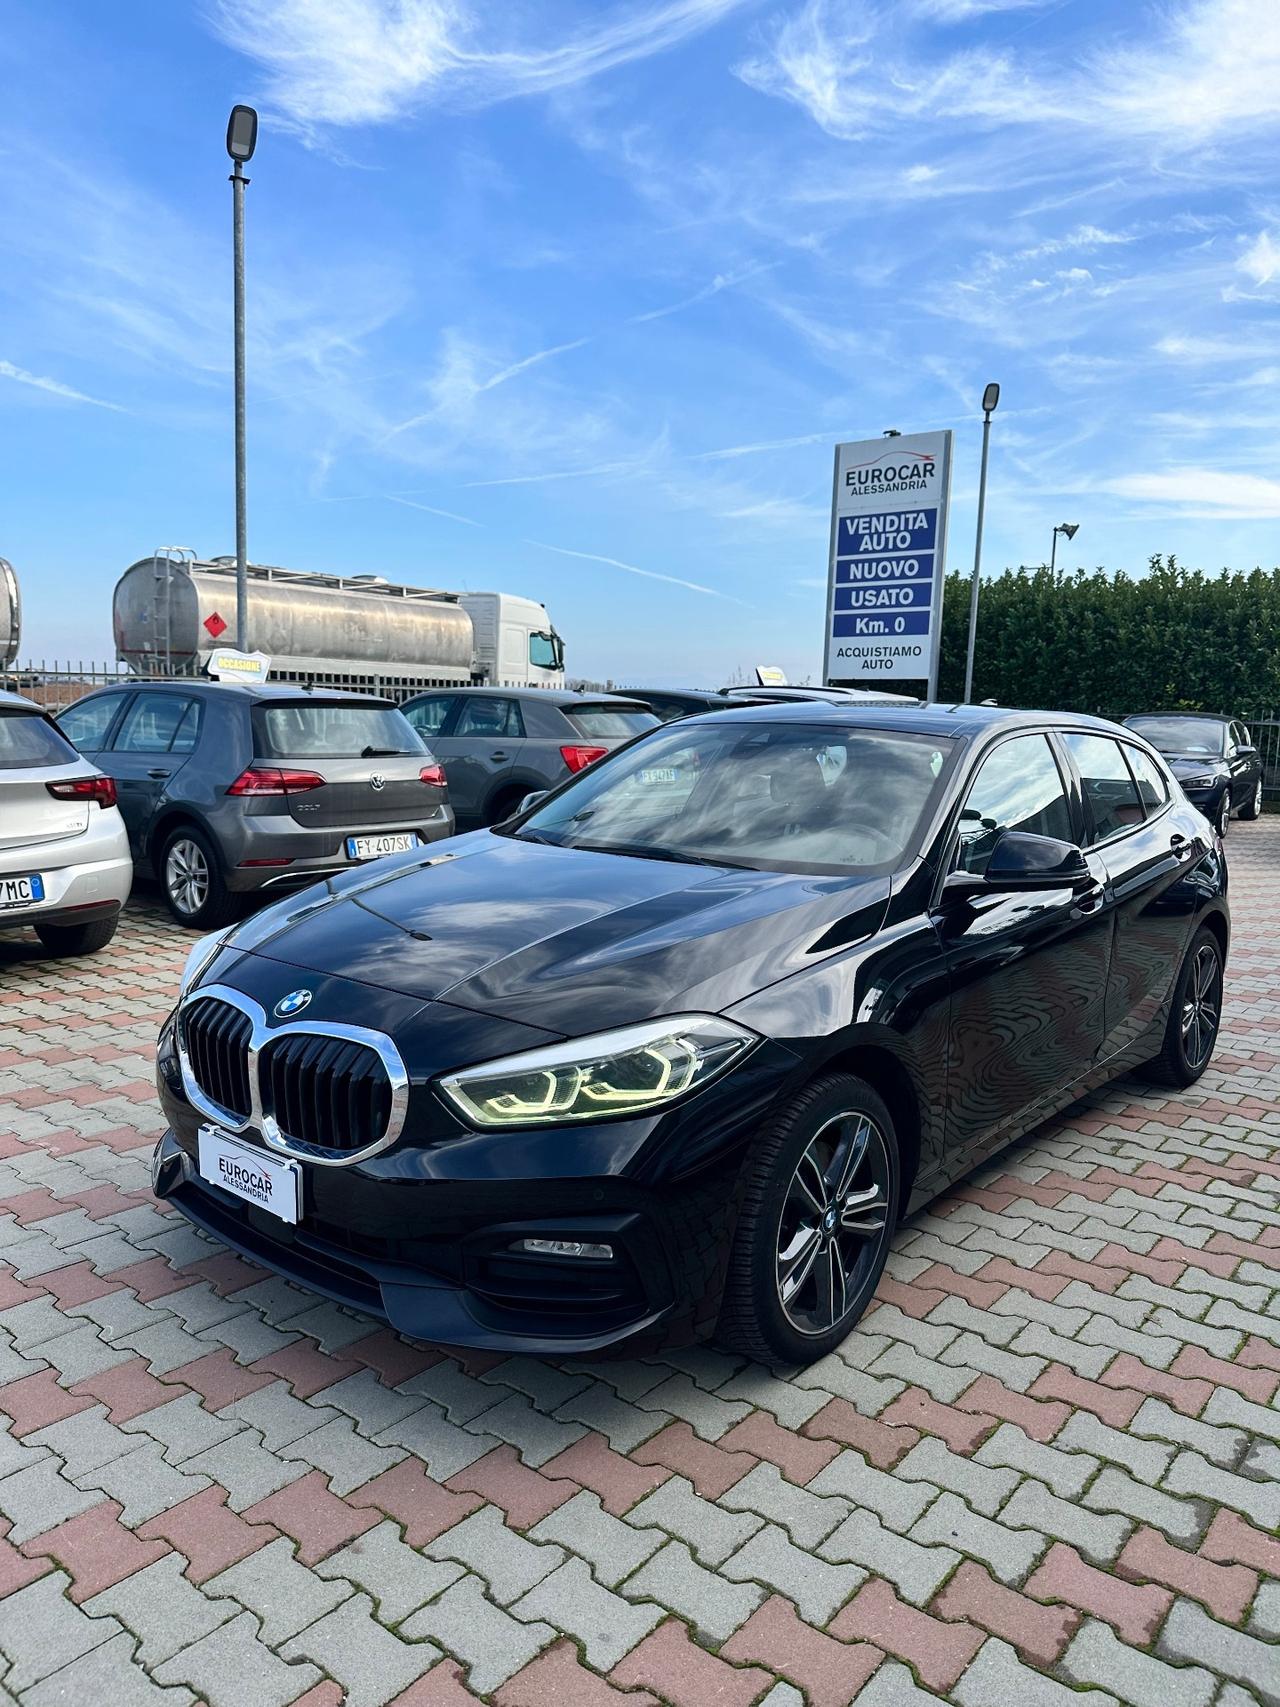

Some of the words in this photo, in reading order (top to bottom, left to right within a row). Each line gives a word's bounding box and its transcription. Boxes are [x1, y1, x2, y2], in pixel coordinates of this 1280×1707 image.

[846, 462, 935, 486] EUROCAR
[851, 480, 927, 496] ALESSANDRIA
[846, 513, 928, 535] VENDITA
[859, 532, 911, 551] AUTO
[850, 559, 919, 579] NUOVO
[851, 588, 914, 607] USATO
[855, 618, 889, 634] Km.
[894, 617, 905, 632] 0
[837, 646, 922, 658] ACQUISTIAMO
[218, 657, 261, 672] OCCASIONE
[861, 659, 894, 670] AUTO
[219, 1157, 272, 1195] EUROCAR
[223, 1175, 269, 1203] ALESSANDRIA
